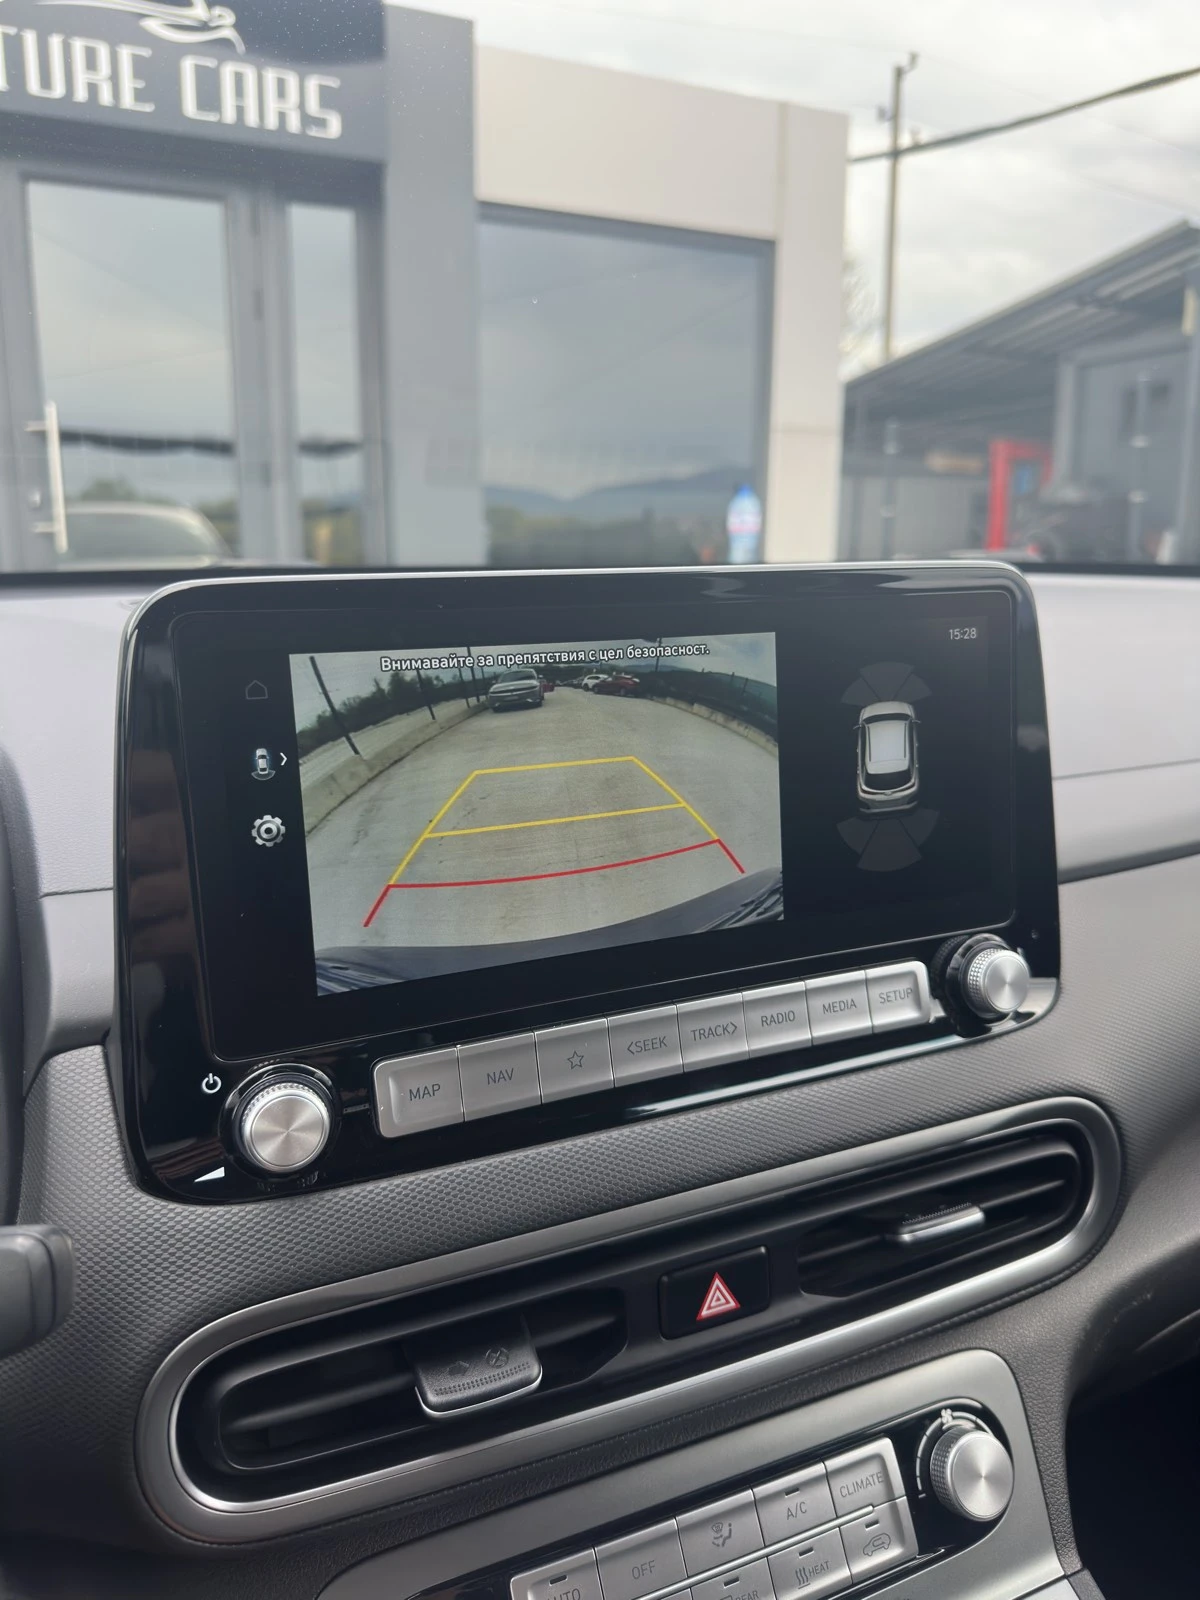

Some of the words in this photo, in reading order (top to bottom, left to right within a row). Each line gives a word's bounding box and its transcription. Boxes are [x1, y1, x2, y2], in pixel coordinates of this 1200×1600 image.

[179, 54, 342, 139] CARS
[949, 628, 977, 640] 15:28
[381, 654, 474, 671] Внимавайте
[477, 654, 494, 667] за
[498, 649, 586, 667] препятствия
[588, 650, 597, 661] с
[600, 648, 624, 660] цел
[627, 644, 710, 659] безопасност.
[878, 986, 914, 1004] SETUP
[822, 998, 858, 1015] MEDIA
[760, 1010, 796, 1027] RADIO
[486, 1068, 515, 1085] NAV
[408, 1082, 442, 1102] MAP
[839, 1471, 884, 1498] CLIMATE
[786, 1501, 807, 1520] A/C
[631, 1560, 656, 1580] OFF
[808, 1561, 830, 1577] HEAT
[547, 1588, 581, 1600] TO
